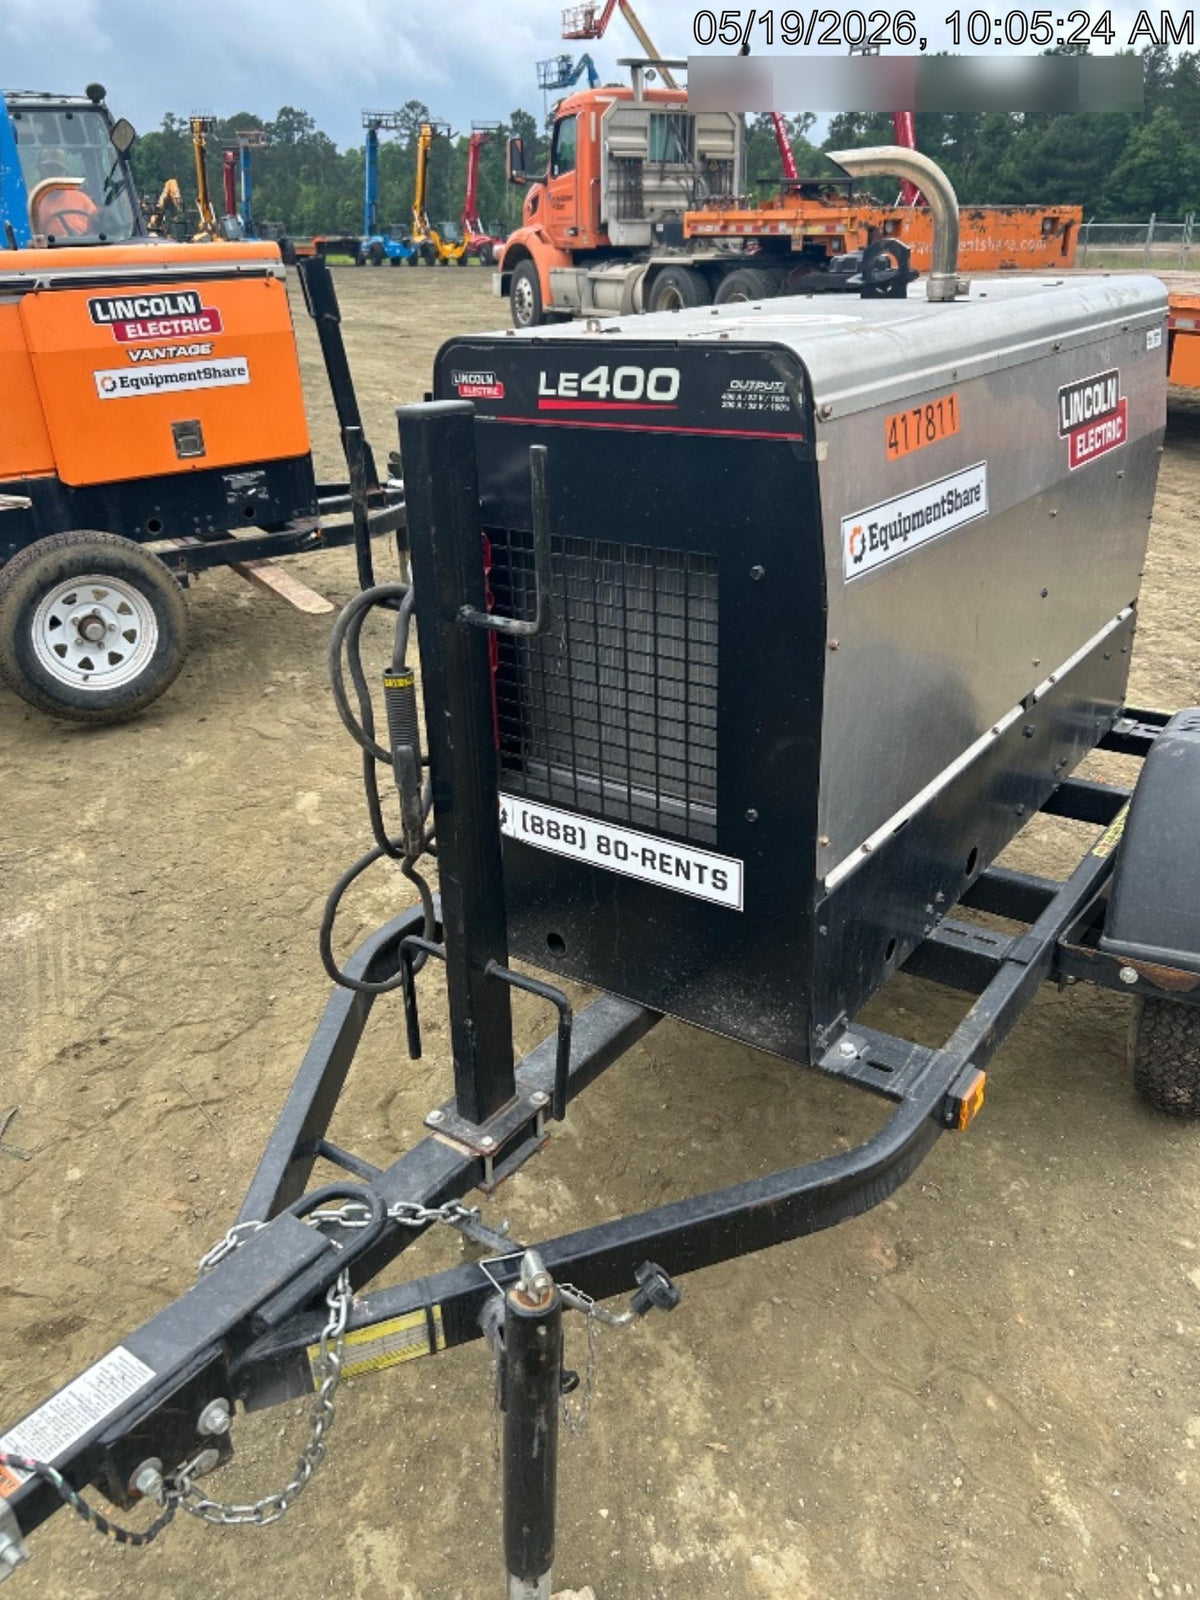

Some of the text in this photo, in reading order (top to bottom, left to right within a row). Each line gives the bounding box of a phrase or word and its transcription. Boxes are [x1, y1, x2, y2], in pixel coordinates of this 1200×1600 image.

[95, 295, 196, 321] LINCOLN
[125, 317, 212, 339] ELECTRIC
[129, 343, 214, 362] VANTAGE
[119, 366, 246, 390] EquipmentShare
[538, 366, 680, 401] LE400
[1061, 377, 1116, 429] LINCOLN
[888, 396, 957, 453] 417811
[1076, 415, 1123, 459] ELECTRIC
[868, 485, 982, 552] EquipmentShare
[521, 810, 728, 892] (888) 80-RENTS
